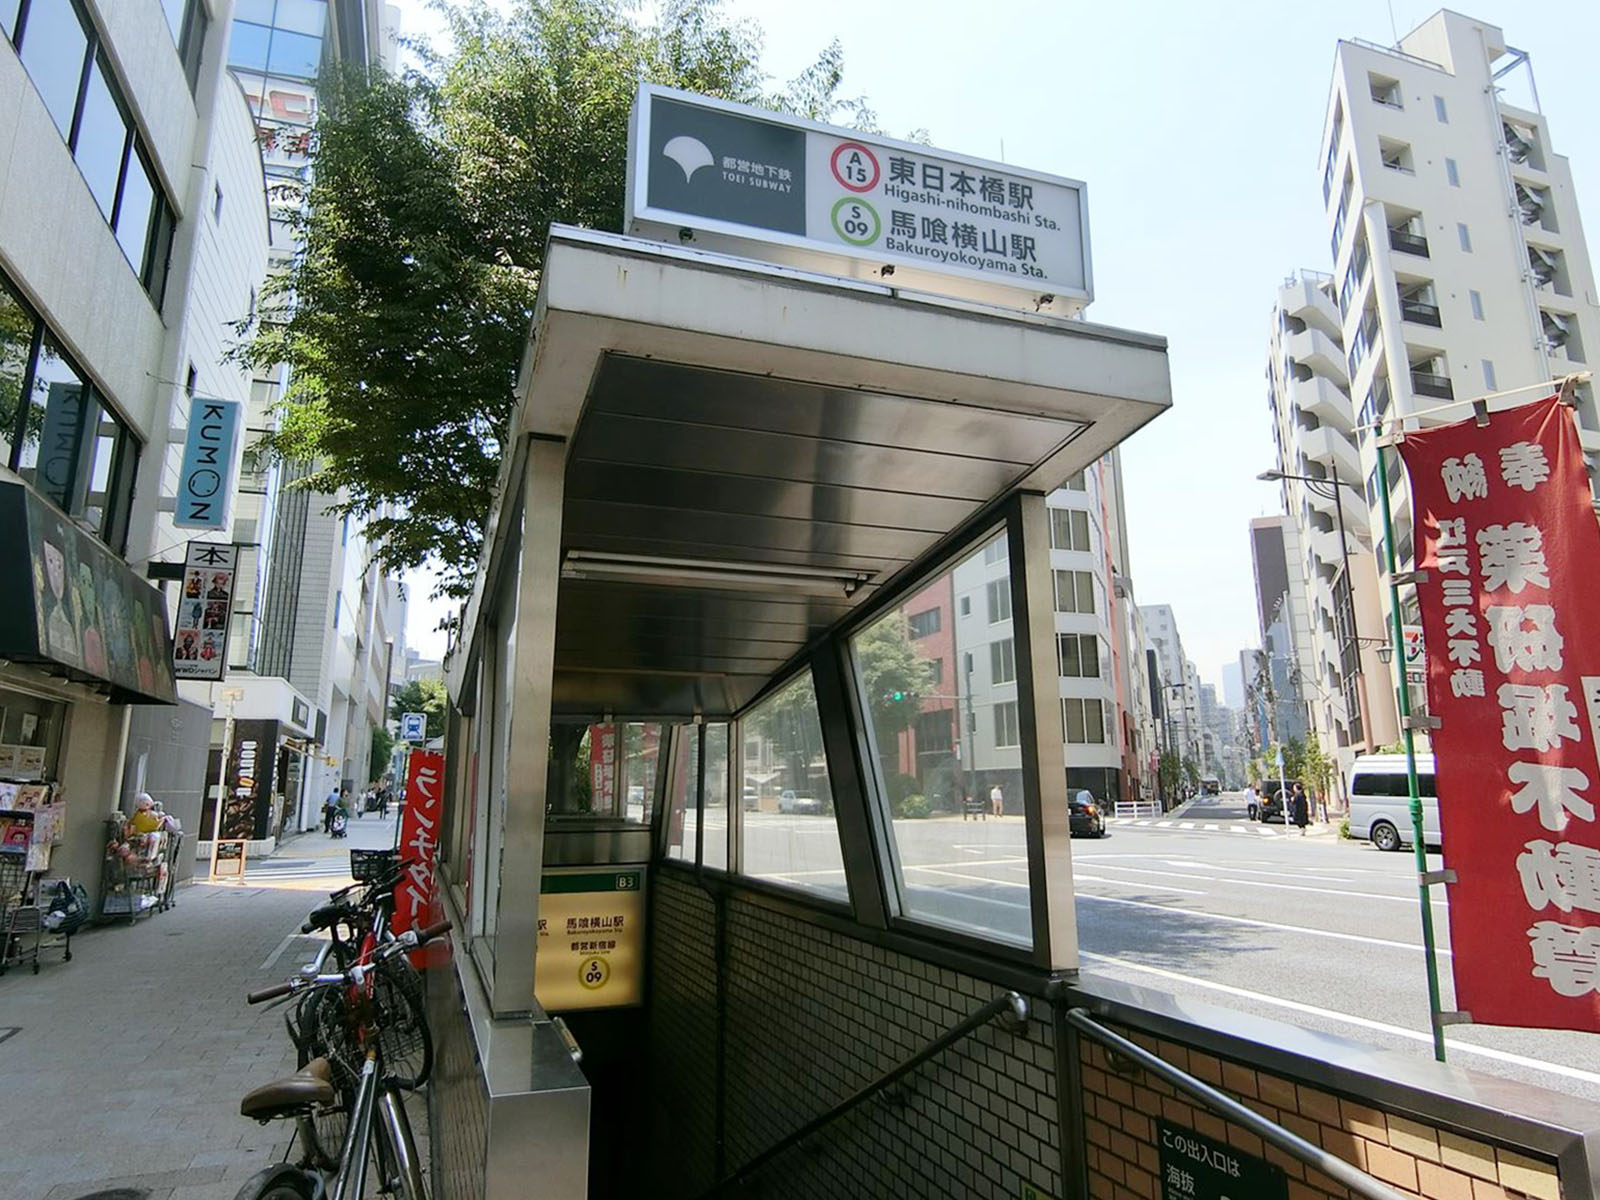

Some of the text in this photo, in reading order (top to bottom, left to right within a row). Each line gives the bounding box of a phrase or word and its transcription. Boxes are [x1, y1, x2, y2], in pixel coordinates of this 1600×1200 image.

[722, 156, 793, 182] 都営地下鉄
[849, 151, 862, 166] A
[722, 171, 793, 194] TOEI SUBWAY
[845, 165, 867, 183] 15
[888, 156, 1034, 211] 東日本橋駅
[851, 205, 861, 220] S
[884, 183, 1061, 232] Higashi-nihombashi Sta.
[844, 220, 868, 236] 09
[890, 209, 1037, 263] 馬喰横山駅
[886, 237, 1048, 280] Bakuroyokoyama Sta.
[187, 404, 225, 521] KUMON
[194, 546, 230, 566] 本
[619, 878, 634, 888] B3
[566, 915, 625, 930] 馬喰横山駅
[591, 961, 598, 972] S
[585, 972, 603, 983] 09
[1162, 1129, 1242, 1178] この出入口は
[1166, 1163, 1196, 1196] 海抜
